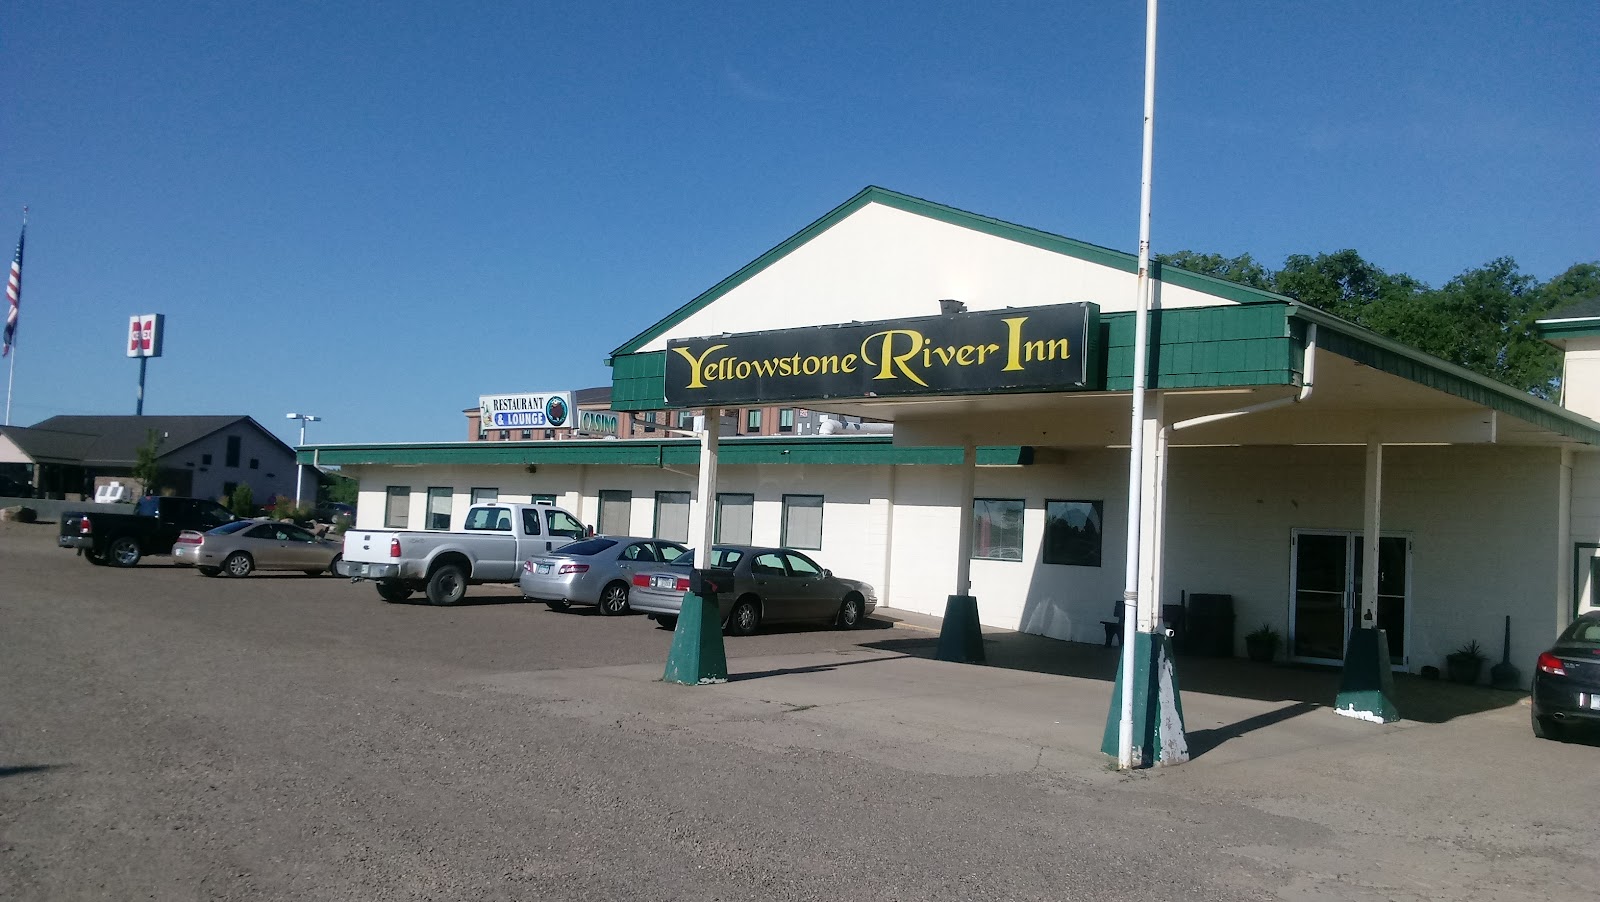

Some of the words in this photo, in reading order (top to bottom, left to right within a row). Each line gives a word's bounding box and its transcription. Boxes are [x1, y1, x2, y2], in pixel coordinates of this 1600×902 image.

[671, 344, 858, 390] Yellowstone
[861, 329, 1000, 388] River
[1000, 317, 1071, 373] Inn
[493, 397, 545, 411] RESTAURANT
[497, 414, 505, 425] &
[509, 412, 544, 425] LOUNGE
[582, 412, 617, 434] CASINO
